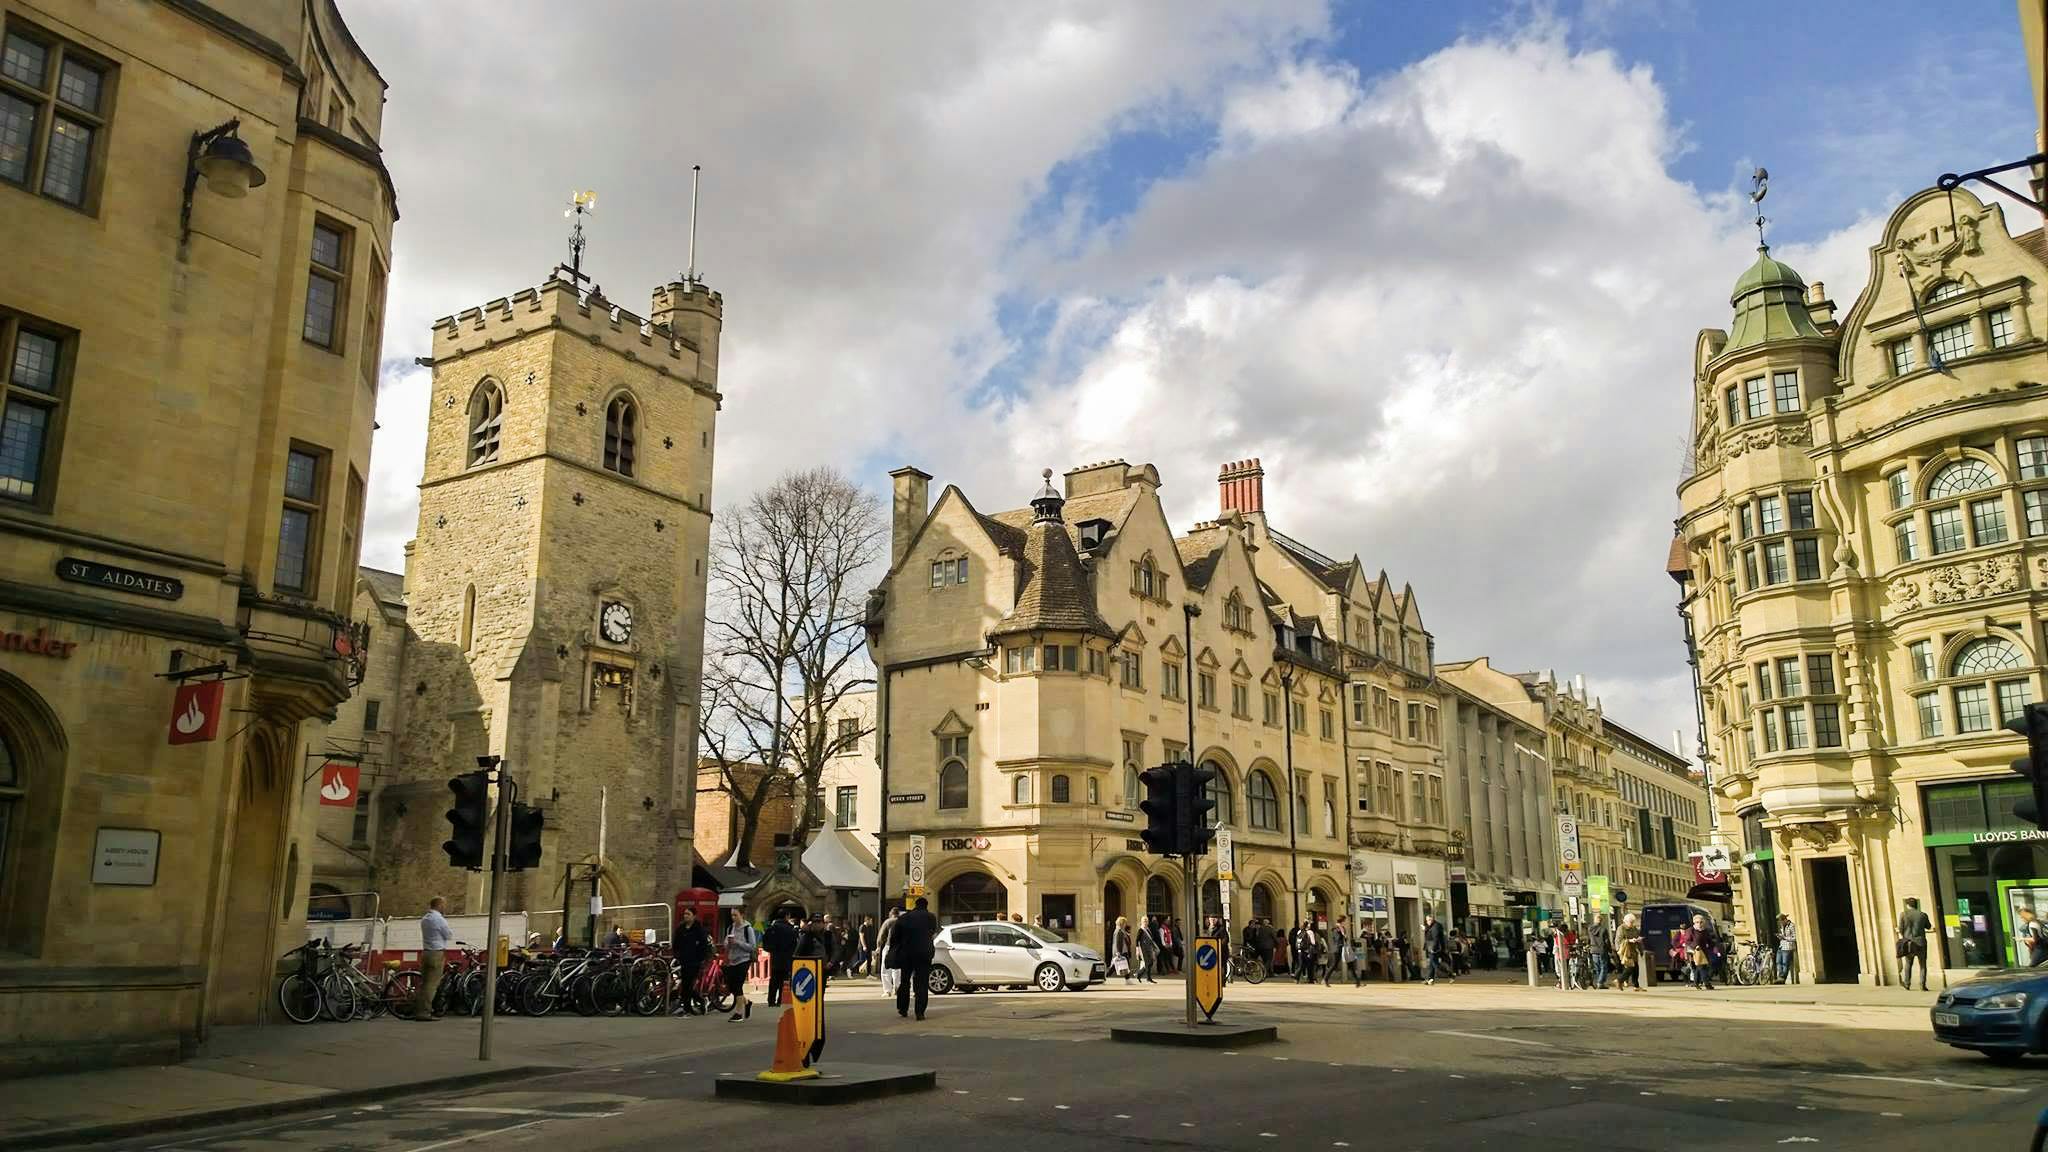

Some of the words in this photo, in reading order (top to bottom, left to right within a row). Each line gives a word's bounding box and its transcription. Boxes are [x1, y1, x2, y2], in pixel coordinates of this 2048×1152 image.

[70, 563, 89, 577] ST
[102, 571, 172, 594] ALDATES
[0, 626, 77, 659] nder
[942, 838, 973, 850] HSBC
[1973, 831, 2017, 843] LLOYDS
